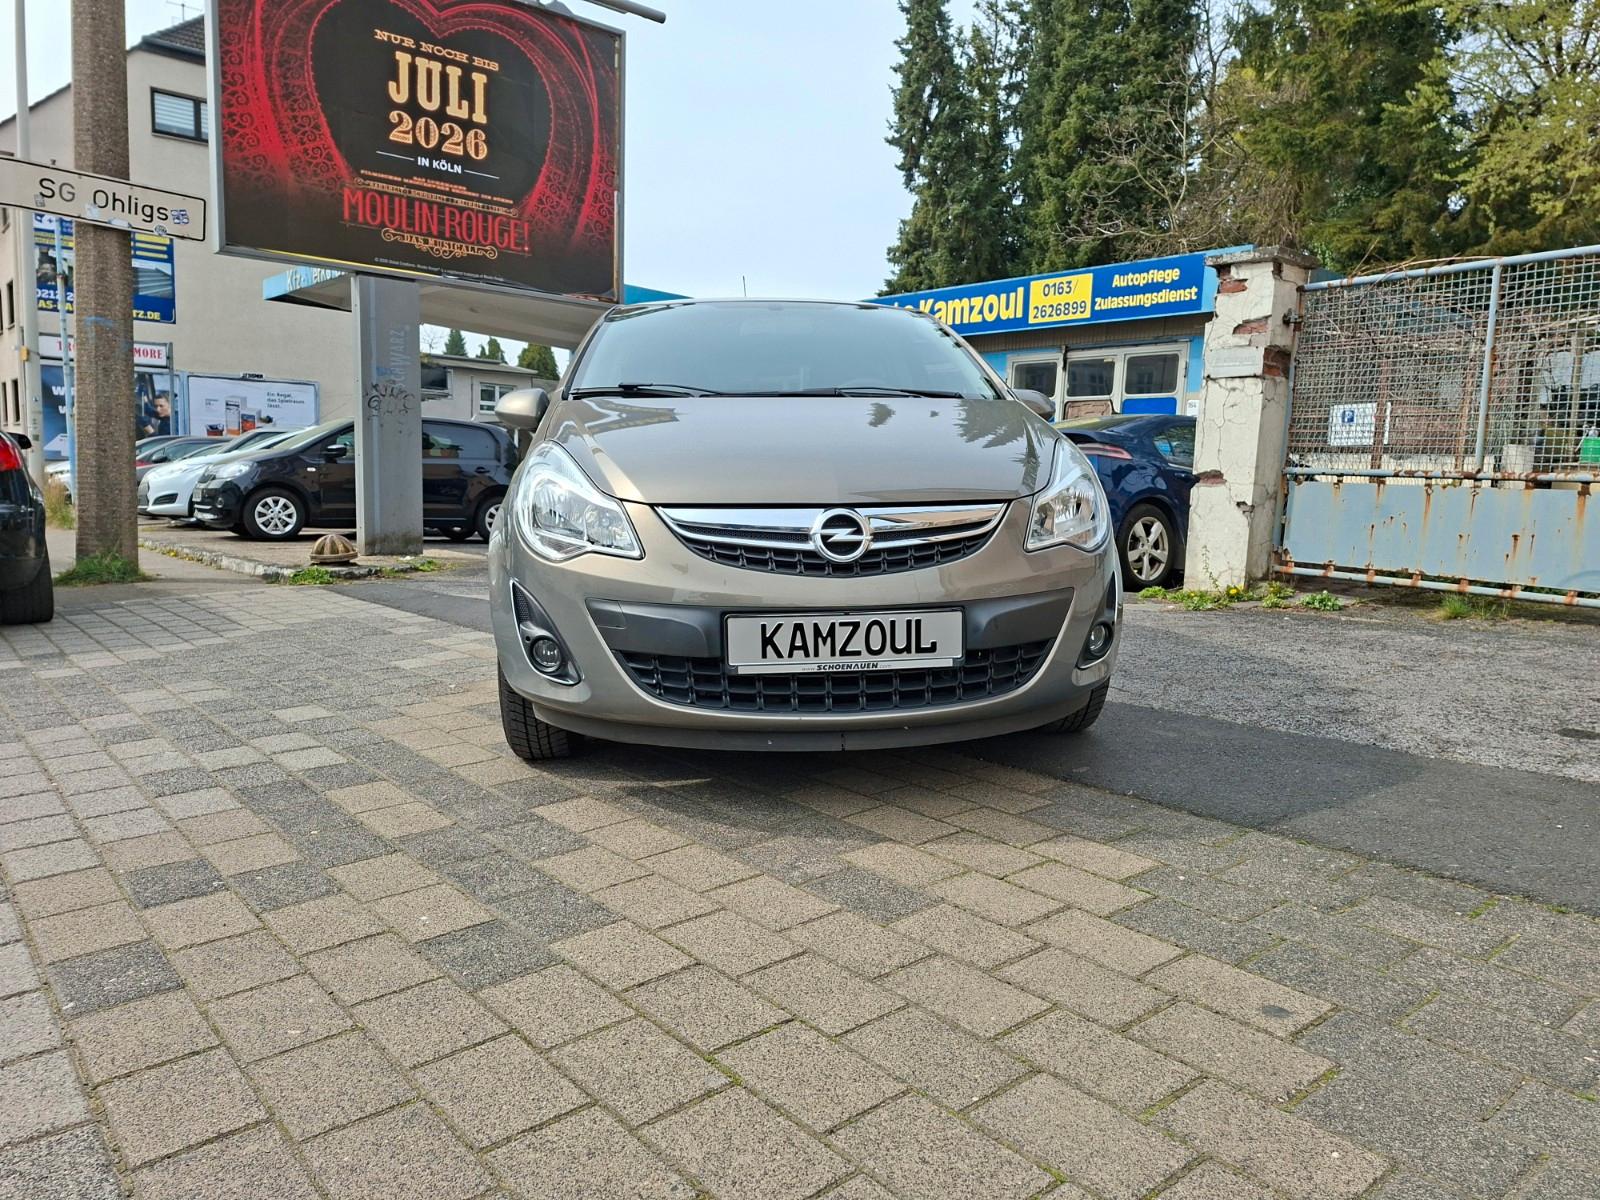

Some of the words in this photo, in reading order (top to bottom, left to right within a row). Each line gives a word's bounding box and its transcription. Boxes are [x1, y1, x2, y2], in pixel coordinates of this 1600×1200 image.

[373, 29, 415, 49] NUR
[420, 41, 469, 63] NOCH
[472, 56, 500, 72] BIS
[388, 51, 488, 124] JULI
[388, 110, 488, 160] 2026
[417, 156, 430, 168] IN
[432, 159, 462, 174] KÖLN
[39, 177, 76, 203] SG
[92, 189, 169, 223] Ohligs
[342, 187, 438, 238] MOULIN
[444, 206, 531, 252] ROUGE!
[403, 232, 424, 245] DAS
[428, 237, 478, 252] MUSICAL
[1094, 285, 1198, 311] Zulassungsdienst
[1112, 268, 1181, 289] Autopflege
[1032, 300, 1087, 319] 2626899
[760, 617, 937, 659] KAMZOUL
